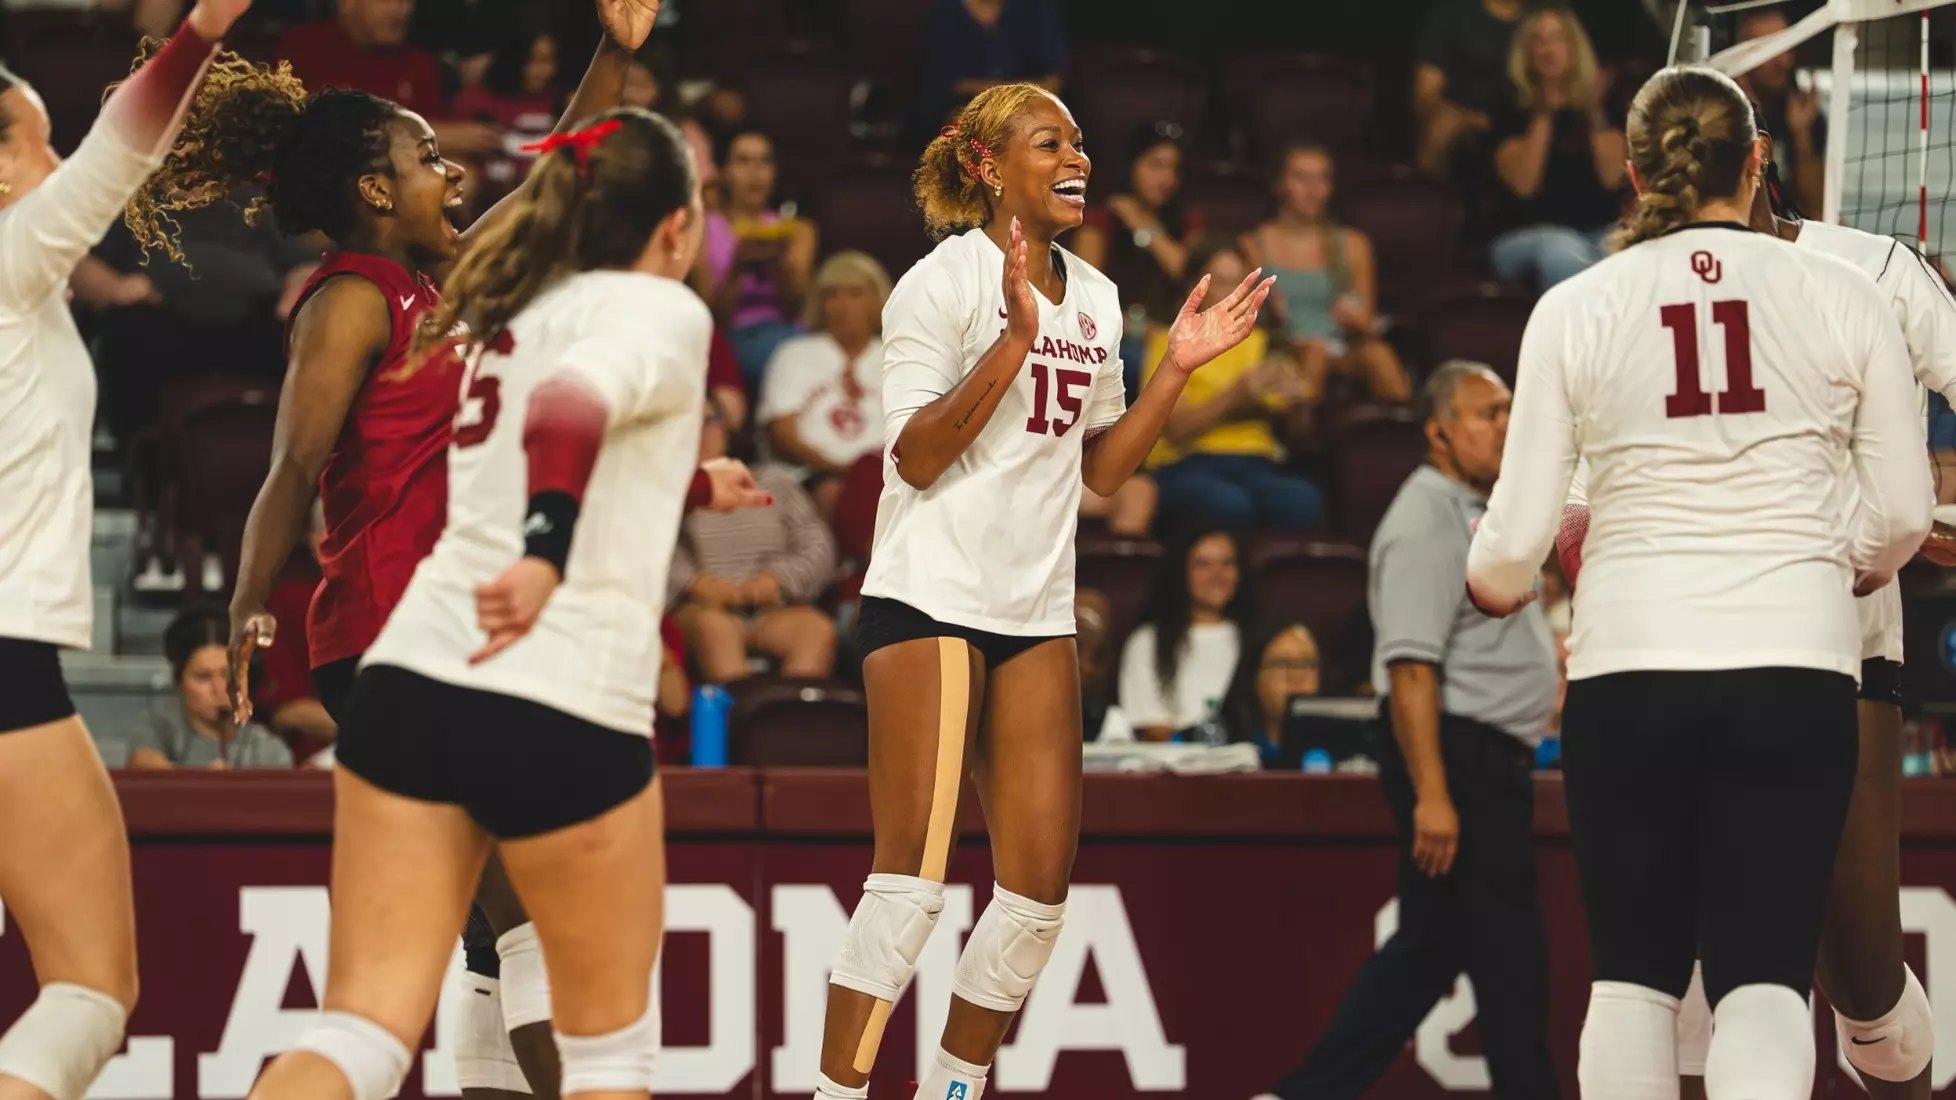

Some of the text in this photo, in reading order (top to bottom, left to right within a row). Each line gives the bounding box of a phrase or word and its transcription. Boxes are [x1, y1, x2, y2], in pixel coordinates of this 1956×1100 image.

[1691, 250, 1721, 284] OU
[1000, 328, 1108, 365] LAHOMA
[1660, 299, 1766, 419] 11
[1026, 363, 1091, 437] 15
